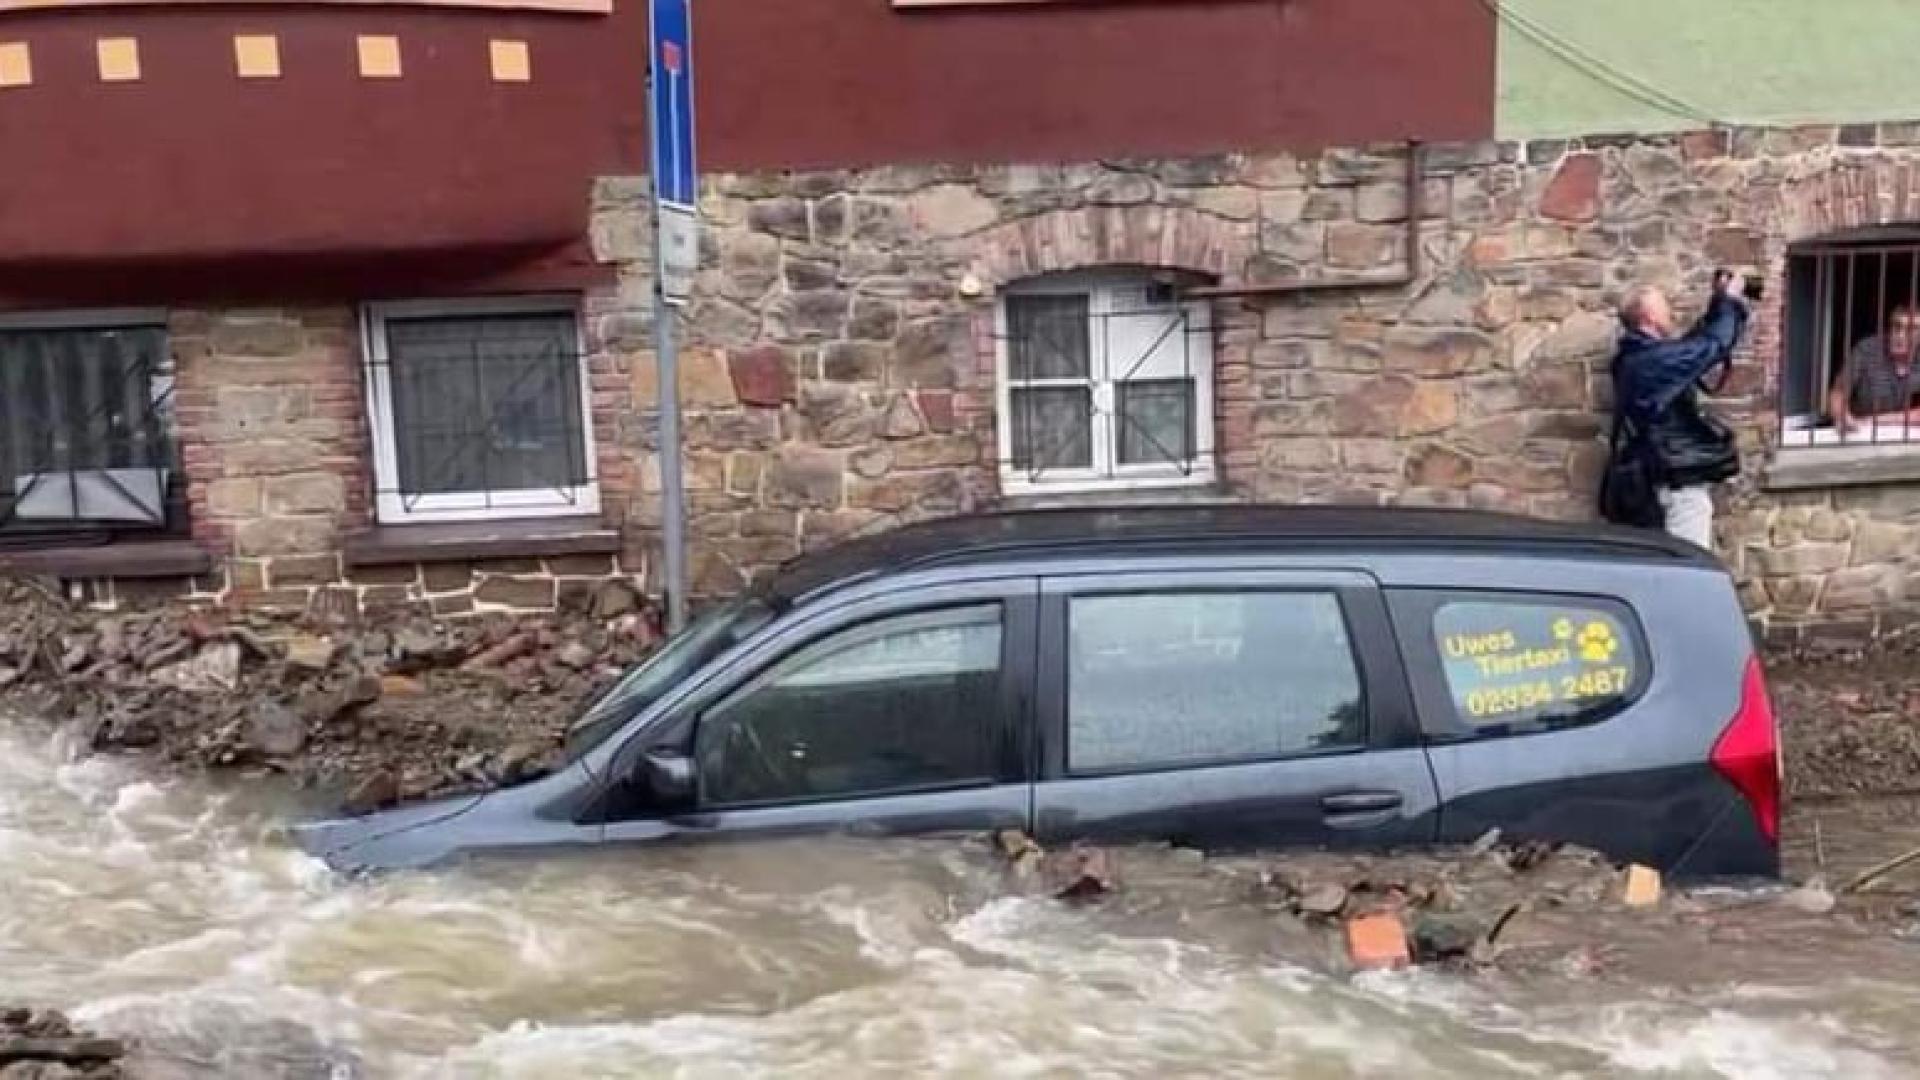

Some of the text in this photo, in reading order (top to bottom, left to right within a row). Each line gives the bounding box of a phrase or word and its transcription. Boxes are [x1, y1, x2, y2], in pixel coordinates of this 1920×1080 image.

[1446, 631, 1515, 656] Uwes
[1477, 648, 1568, 676] Tiertaxi
[1561, 666, 1626, 698] 2487
